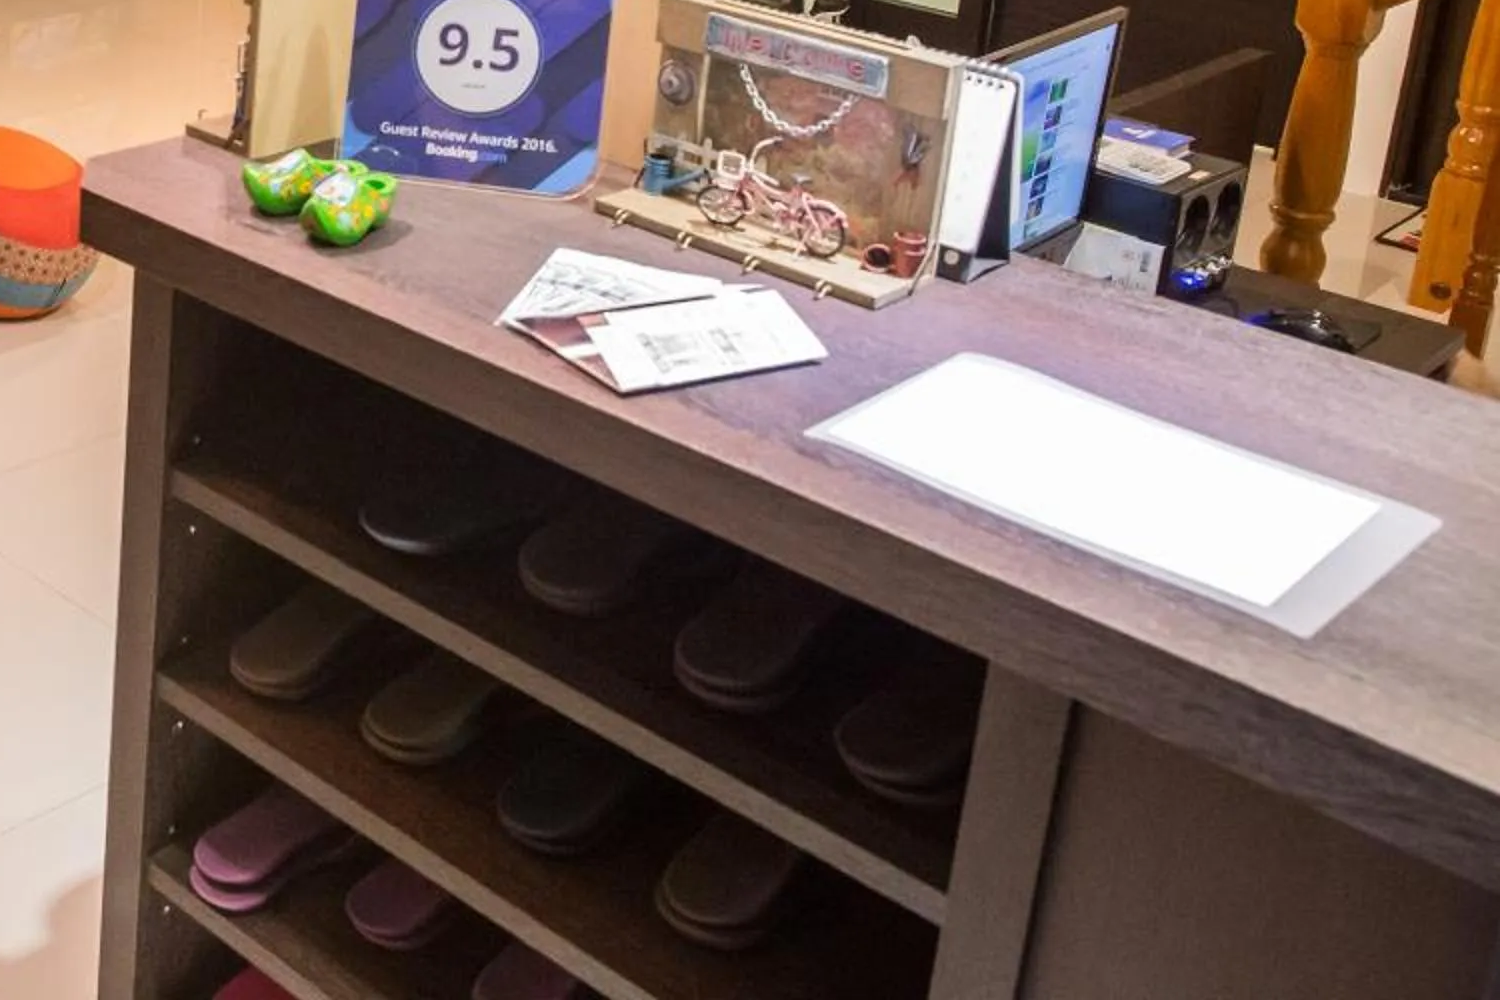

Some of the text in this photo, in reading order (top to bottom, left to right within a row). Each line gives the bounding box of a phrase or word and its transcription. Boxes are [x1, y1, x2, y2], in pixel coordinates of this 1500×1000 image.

[438, 23, 519, 72] 9.5
[380, 121, 418, 137] Guest
[421, 126, 467, 143] Review
[469, 132, 518, 150] Awards
